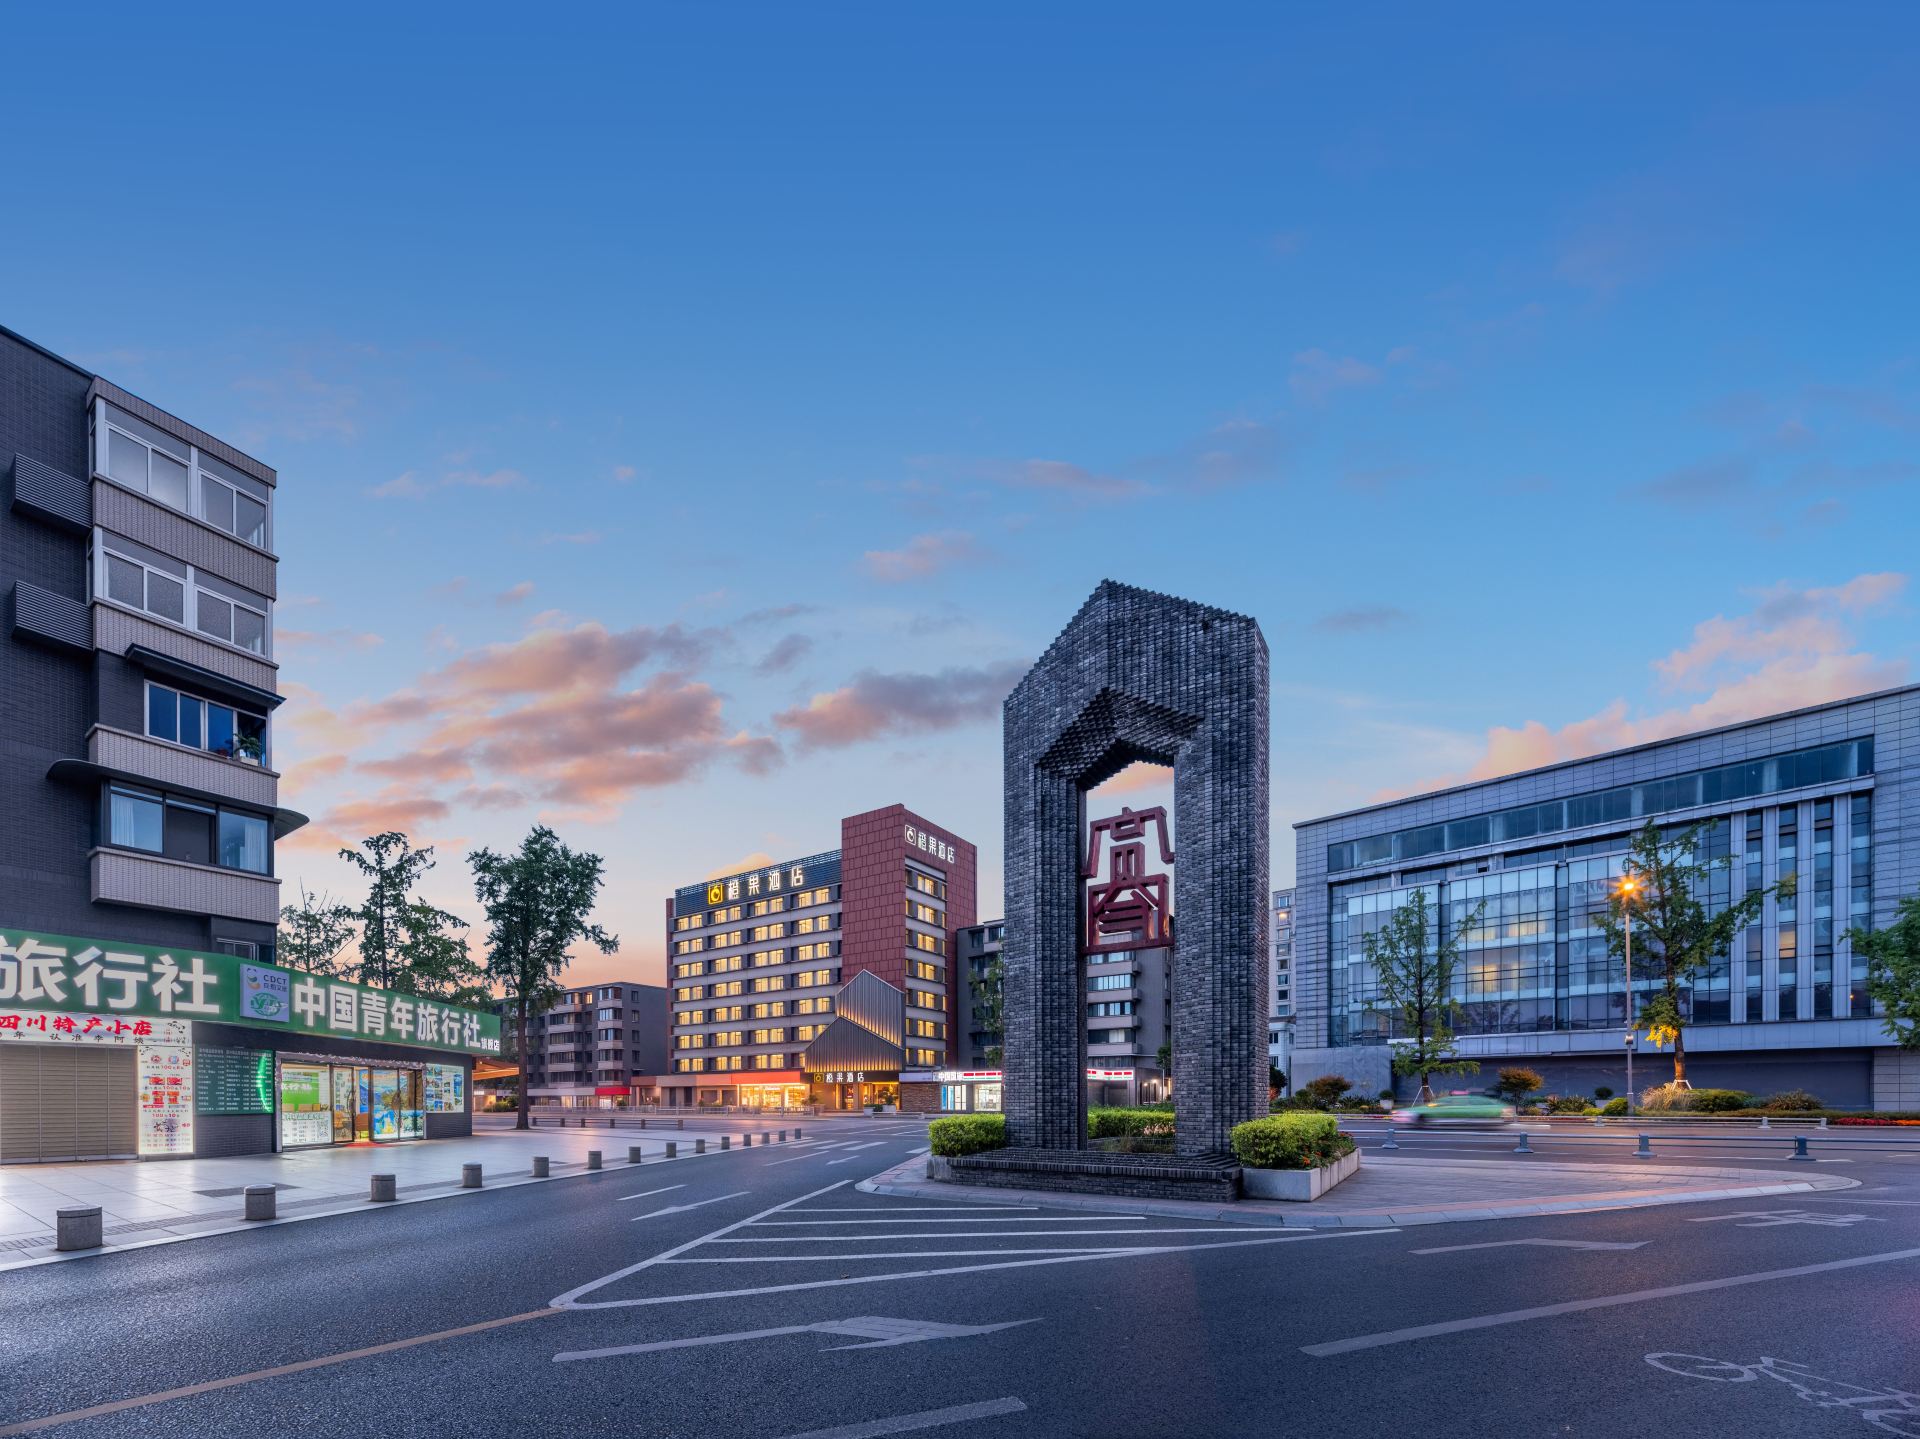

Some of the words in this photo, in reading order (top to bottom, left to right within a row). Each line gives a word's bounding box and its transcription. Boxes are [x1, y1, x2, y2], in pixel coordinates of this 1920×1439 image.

[918, 831, 954, 863] 橙果酒店
[727, 864, 804, 900] 橙果酒店
[0, 935, 220, 1014] 旅行社
[263, 975, 287, 985] CDCT
[0, 1015, 153, 1035] 四川特产小店
[294, 977, 481, 1048] 中国青年旅行社
[826, 1072, 864, 1083] 橙果酒店
